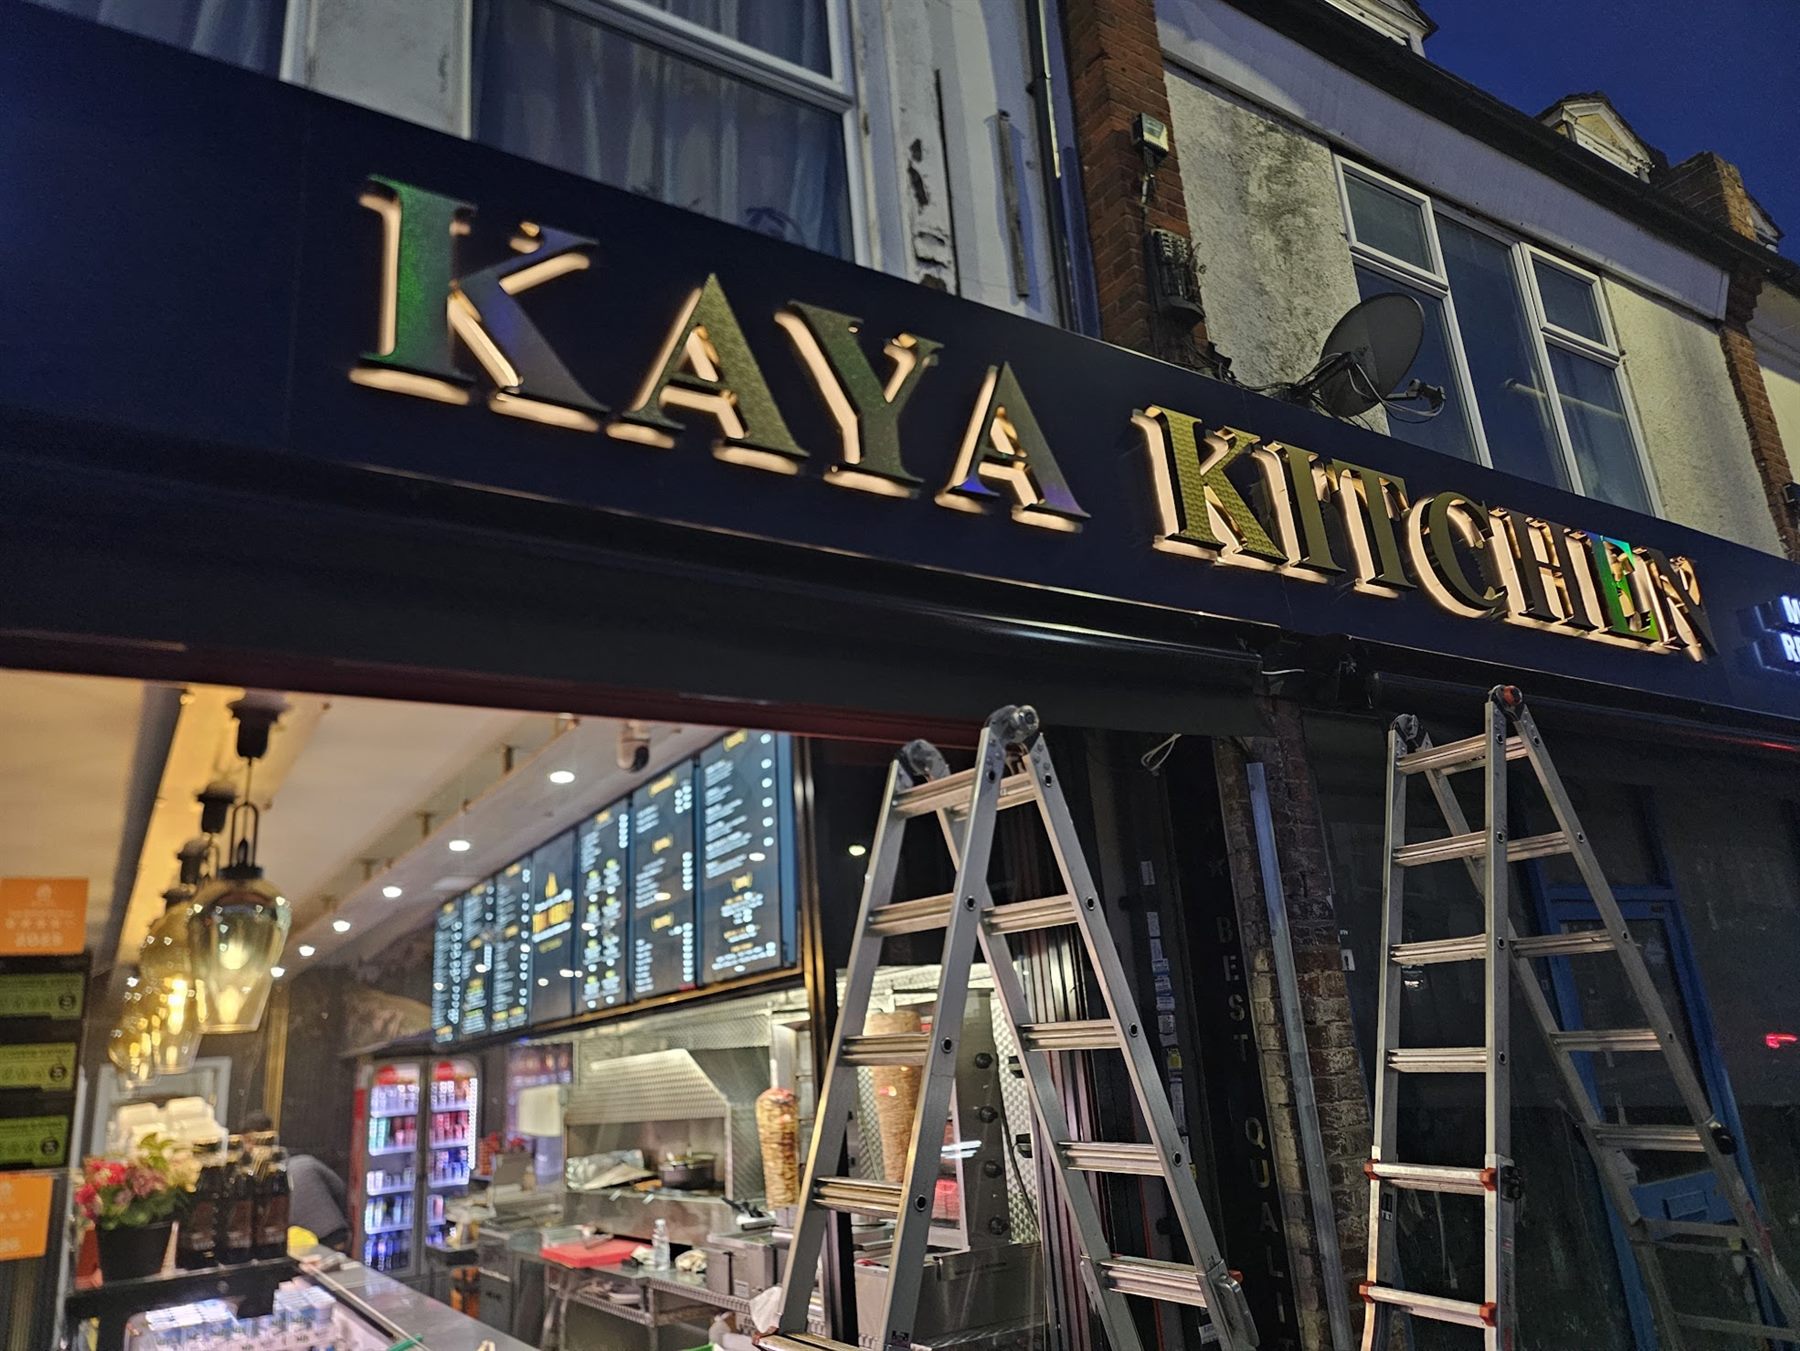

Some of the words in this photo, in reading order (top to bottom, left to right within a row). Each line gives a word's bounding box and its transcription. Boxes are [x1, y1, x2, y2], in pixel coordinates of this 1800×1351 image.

[354, 174, 1091, 530] KAYA
[1133, 404, 1718, 660] KITCHEN
[1215, 915, 1249, 1063] BEST
